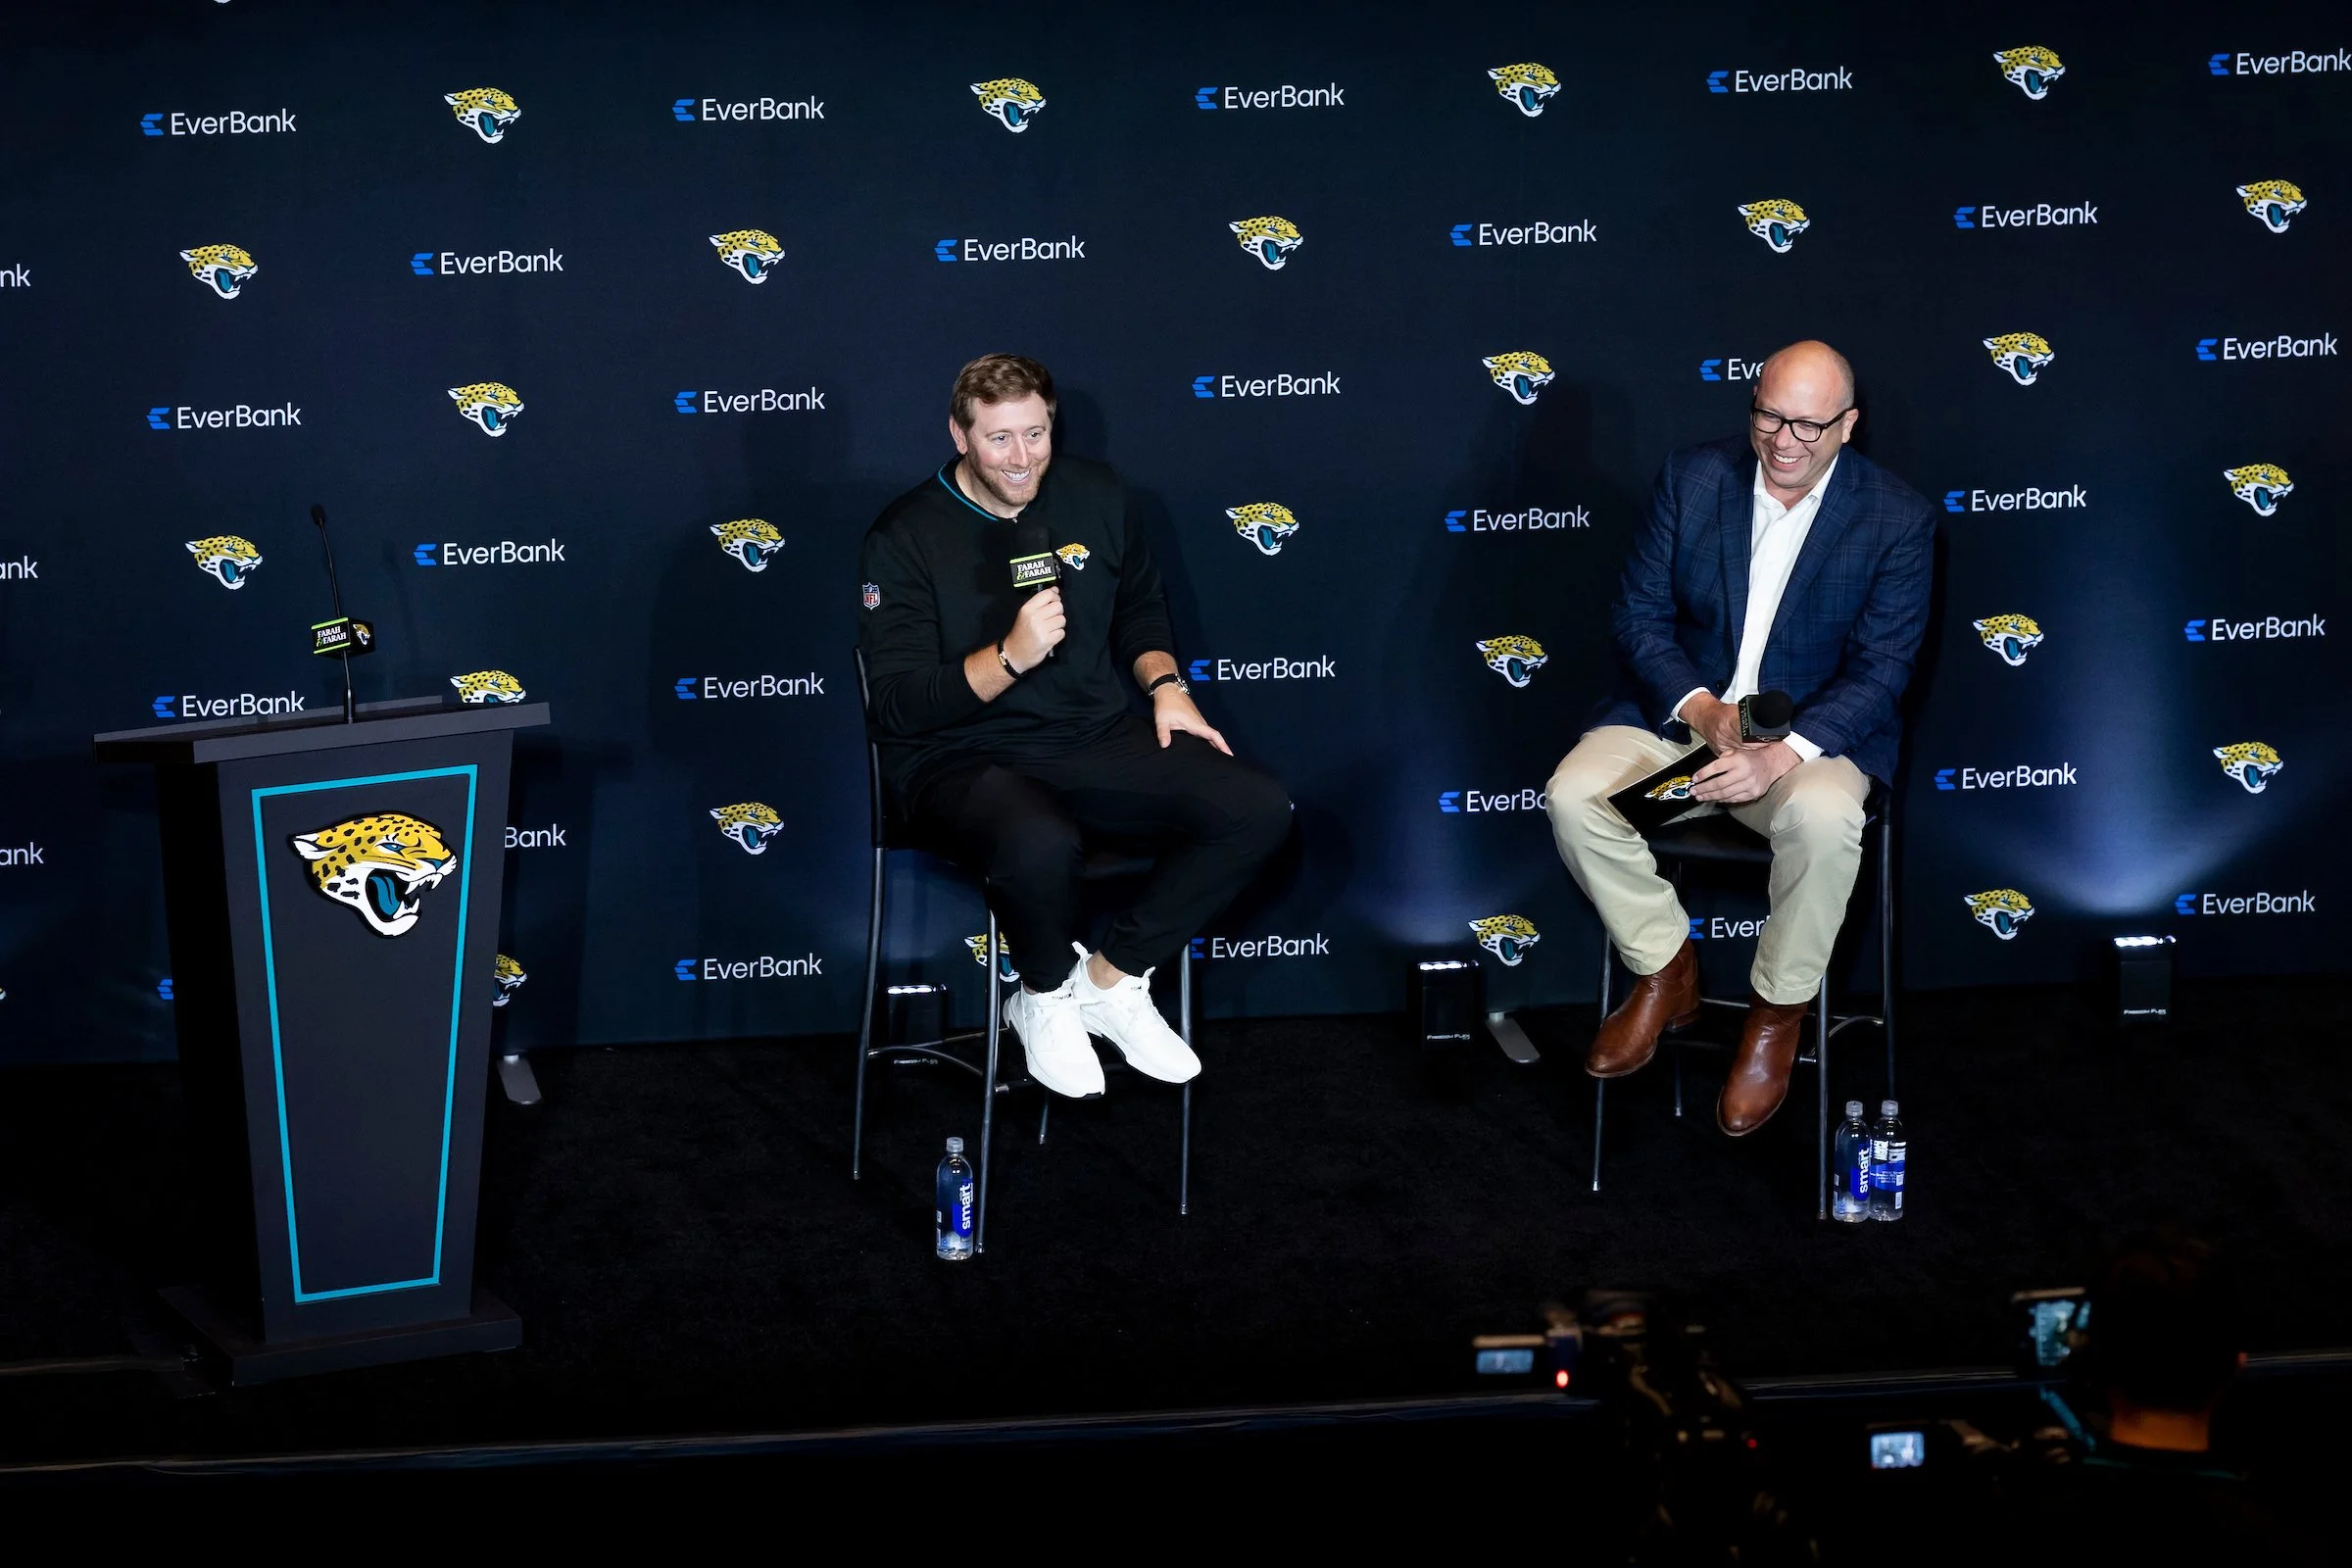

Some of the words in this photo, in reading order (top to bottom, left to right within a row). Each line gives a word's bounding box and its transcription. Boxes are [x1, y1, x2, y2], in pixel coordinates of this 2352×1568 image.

[2235, 47, 2352, 75] EverBank
[1735, 65, 1853, 93] EverBank
[702, 95, 825, 122] EverBank
[1224, 81, 1345, 110] EverBank
[171, 108, 297, 136] EverBank
[1982, 200, 2098, 228] EverBank
[1479, 219, 1597, 246] EverBank
[440, 247, 564, 275] EverBank
[963, 234, 1086, 262] EverBank
[2223, 331, 2338, 361] EverBank
[1221, 370, 1342, 398] EverBank
[704, 386, 826, 414] EverBank
[176, 401, 302, 429] EverBank
[1971, 483, 2087, 513] EverBank
[1473, 504, 1591, 532] EverBank
[443, 537, 565, 565] EverBank
[1017, 560, 1045, 571] FARAH
[1024, 566, 1052, 578] FARAH
[317, 626, 341, 638] FARAH
[322, 632, 347, 644] FARAH
[2211, 612, 2326, 641] EverBank
[1217, 654, 1336, 681] EverBank
[704, 671, 825, 699] EverBank
[182, 690, 305, 717] EverBank
[1962, 761, 2078, 790] EverBank
[2202, 889, 2316, 915] EverBank
[1711, 914, 1771, 939] Ever
[1211, 932, 1330, 958] EverBank
[704, 952, 822, 980] EverBank
[1858, 1148, 1869, 1193] smart
[959, 1183, 971, 1230] smart
